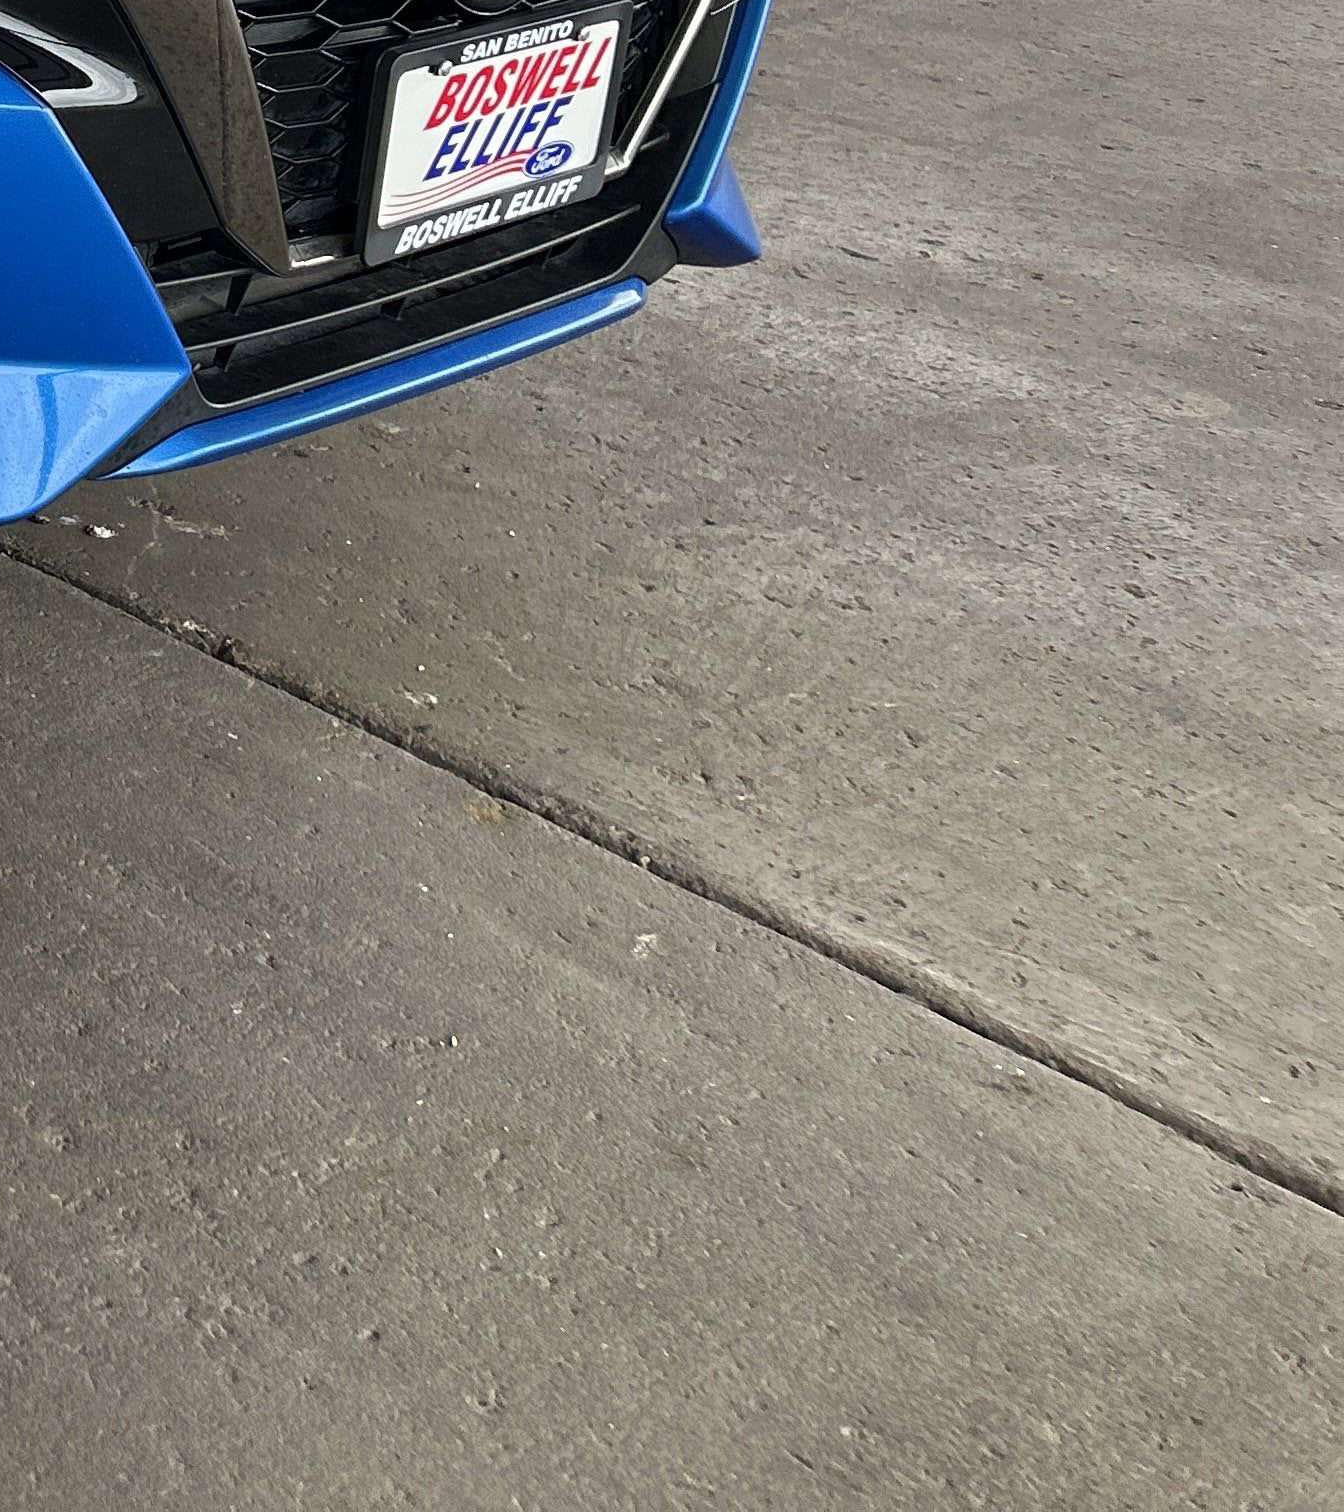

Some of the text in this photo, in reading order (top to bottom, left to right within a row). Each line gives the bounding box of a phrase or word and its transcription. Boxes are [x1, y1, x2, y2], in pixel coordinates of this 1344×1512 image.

[461, 20, 573, 63] SAN BENITO
[423, 37, 612, 131] BOSWELL
[422, 95, 574, 182] ELLIFF
[531, 147, 566, 172] Ford
[394, 175, 582, 255] BOSWELL ELLIFF
